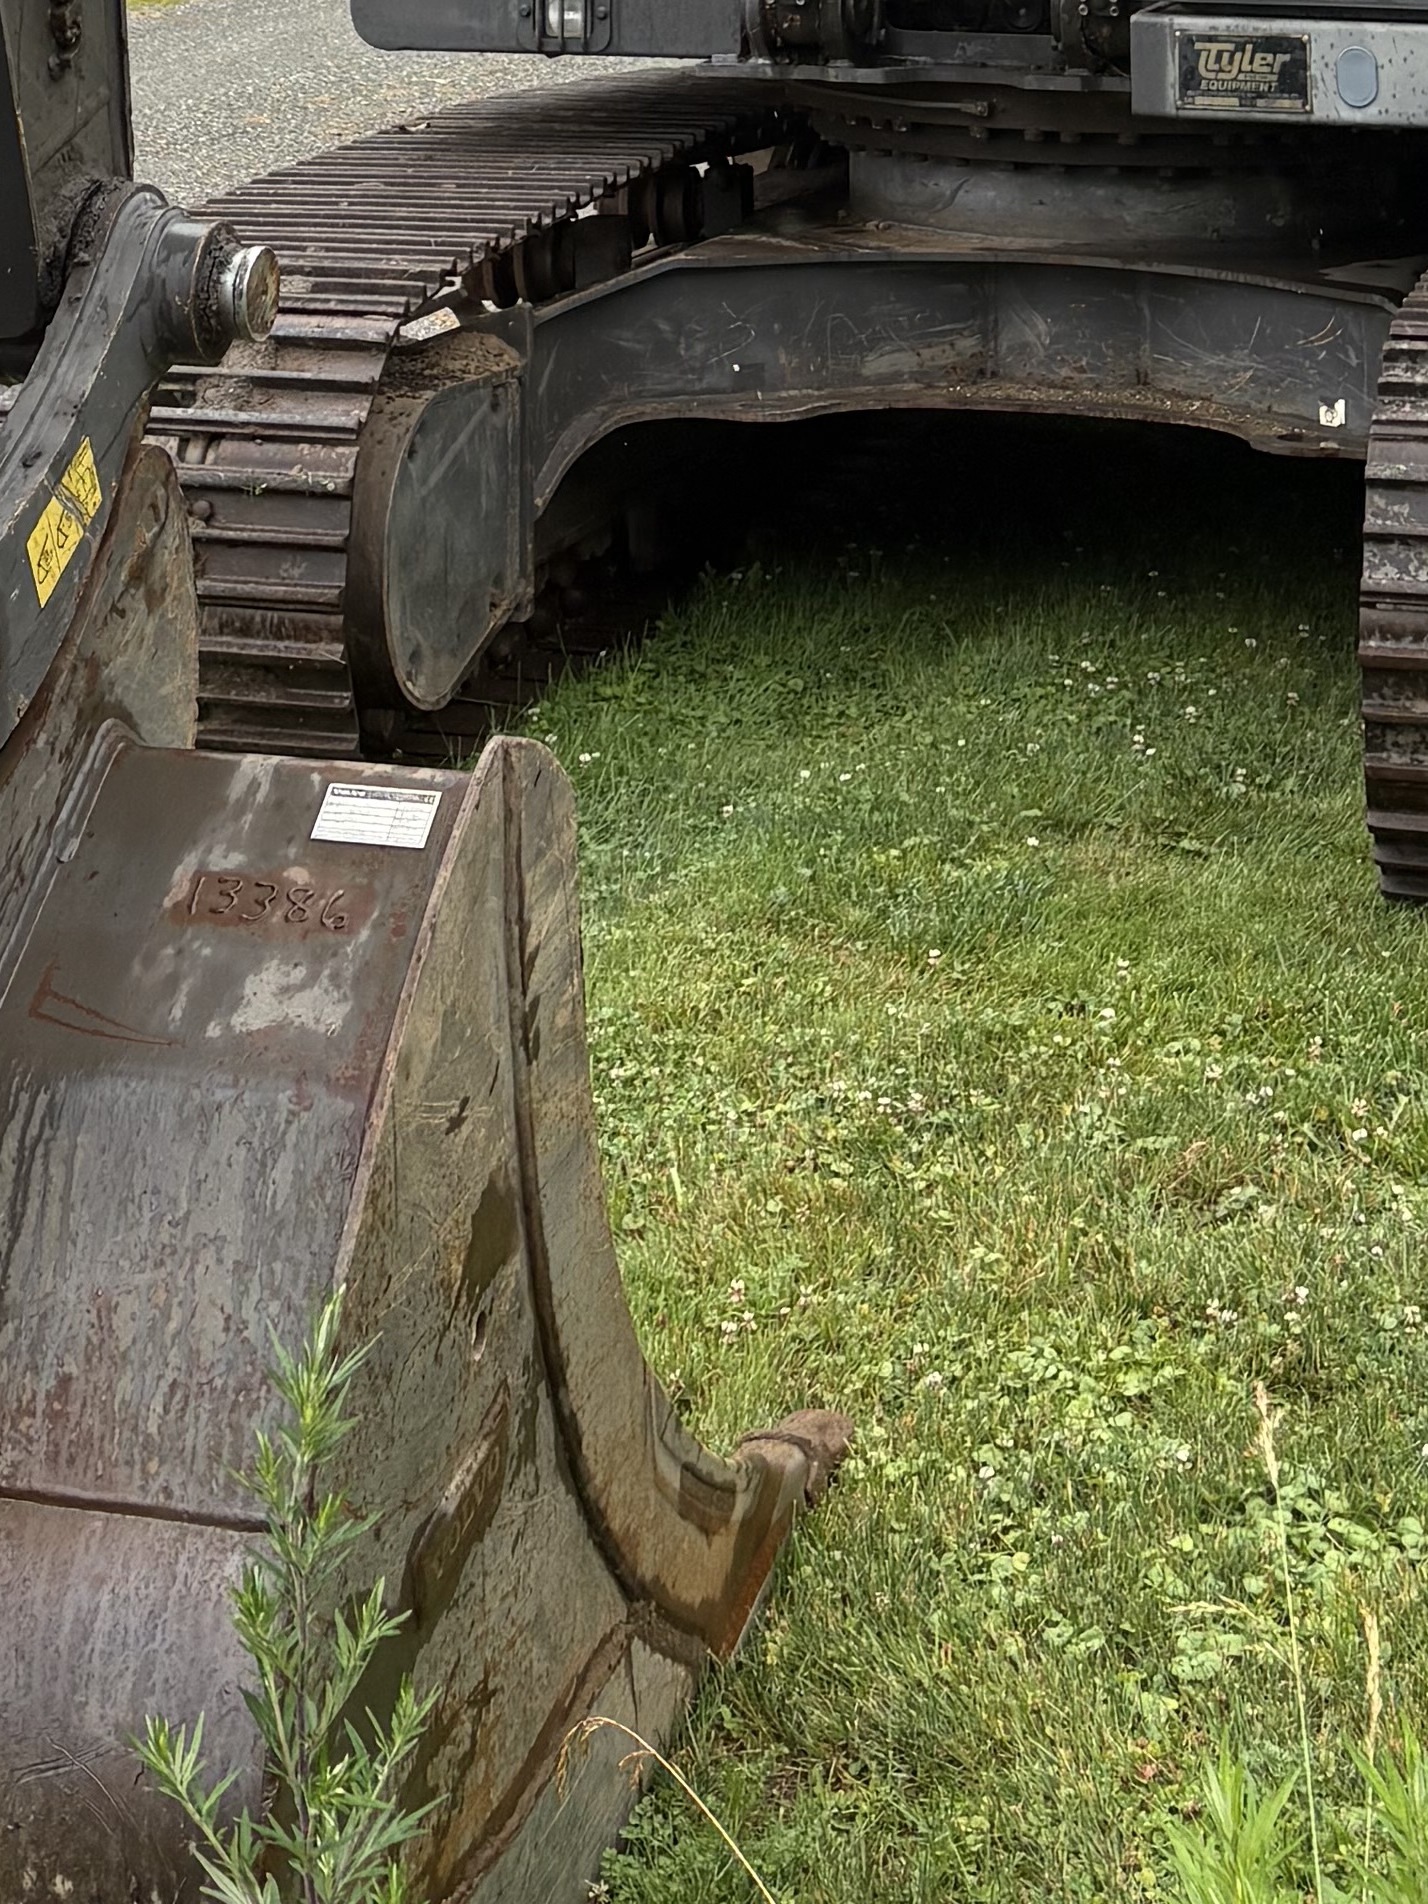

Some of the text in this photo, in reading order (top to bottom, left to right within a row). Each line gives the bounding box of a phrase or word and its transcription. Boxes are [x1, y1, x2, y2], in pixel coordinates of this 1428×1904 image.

[1193, 41, 1292, 81] Tyler
[1199, 79, 1279, 93] EQUIPMENT
[188, 875, 348, 931] 13386
